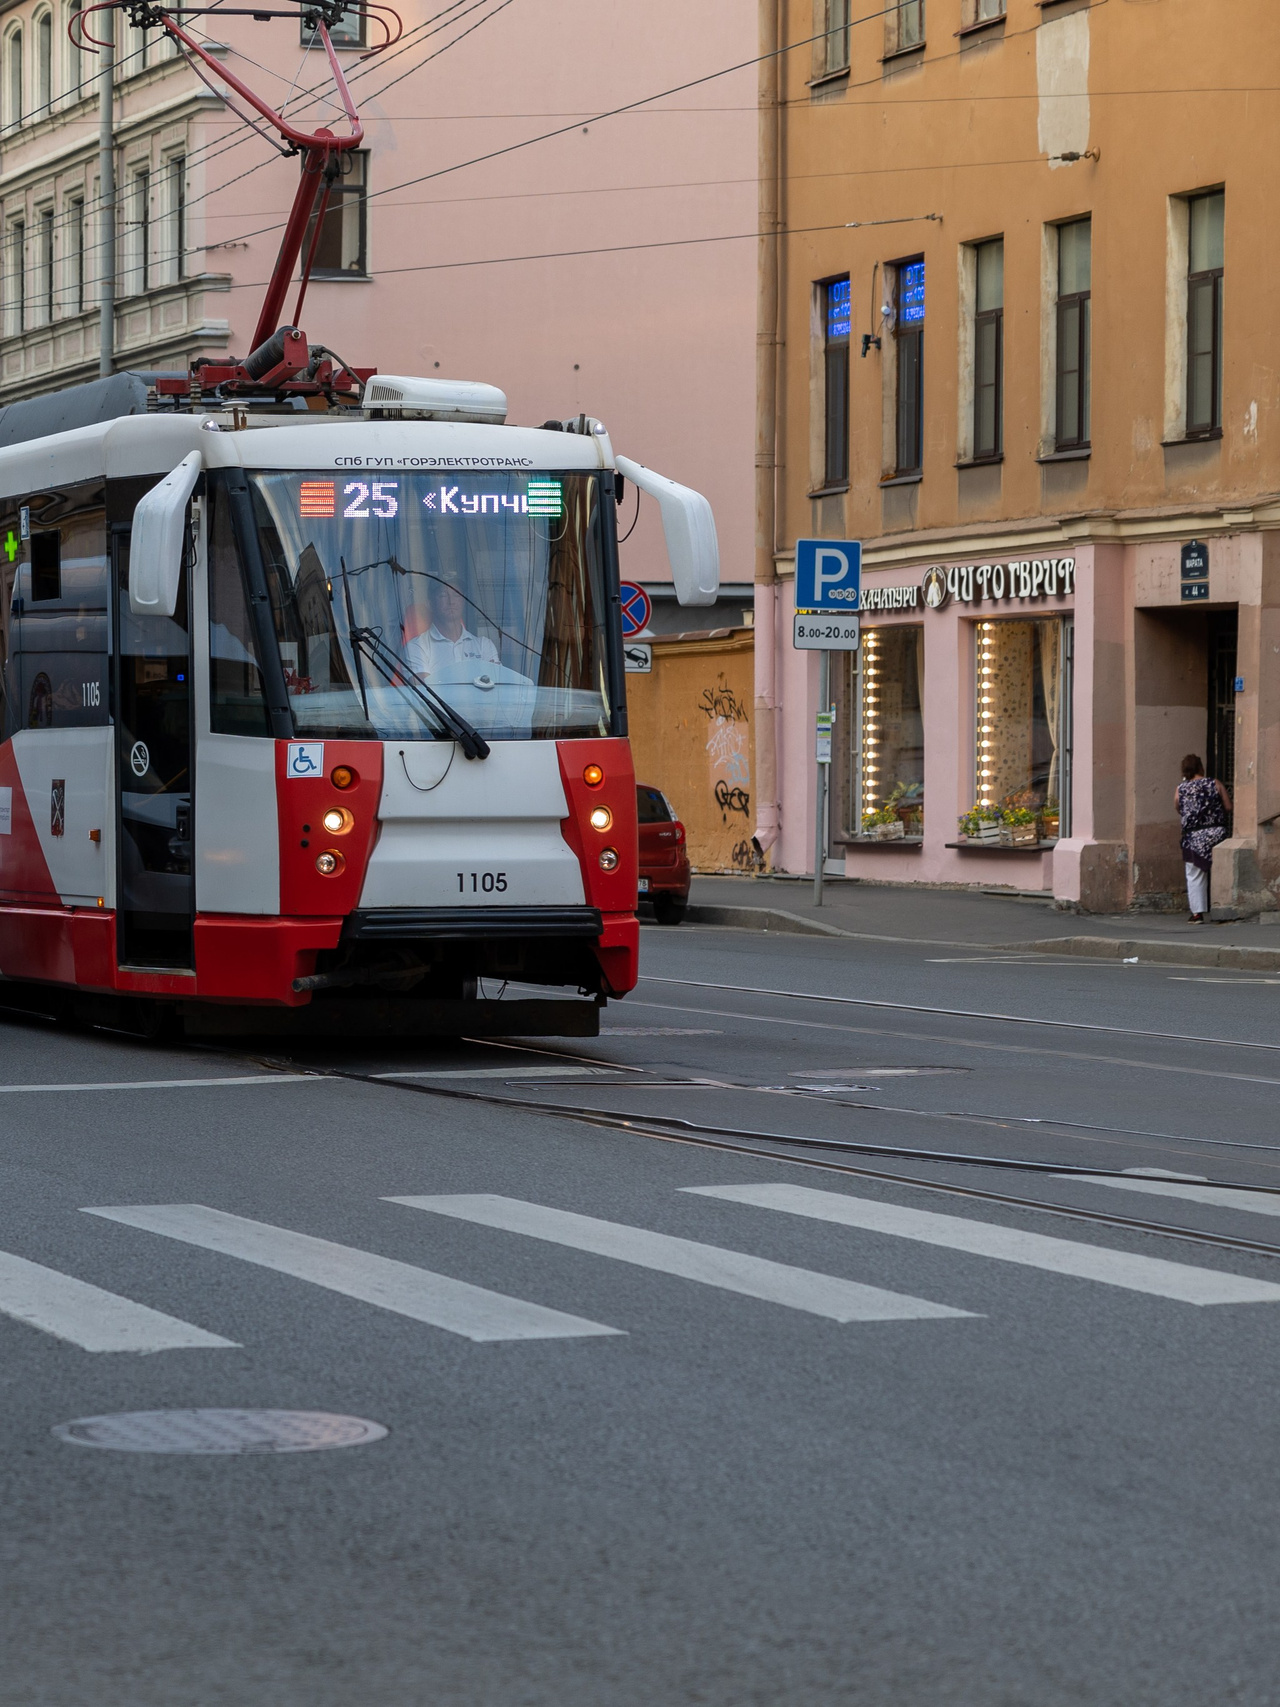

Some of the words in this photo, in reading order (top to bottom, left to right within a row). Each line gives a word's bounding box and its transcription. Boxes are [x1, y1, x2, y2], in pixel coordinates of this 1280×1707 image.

[334, 456, 363, 466] СПб
[366, 457, 394, 466] ГУП
[397, 457, 534, 467] «ГОРЭЛЕКТРОТРАНС»
[343, 482, 398, 518] 25
[1185, 558, 1203, 568] МАРАТА
[860, 585, 918, 610] ХАЧАПУРИ
[1008, 557, 1076, 599] ГВРИТ
[1191, 585, 1198, 597] 44
[797, 625, 856, 639] 8.00-20.00
[82, 682, 100, 707] 1105
[457, 872, 508, 892] 1105
